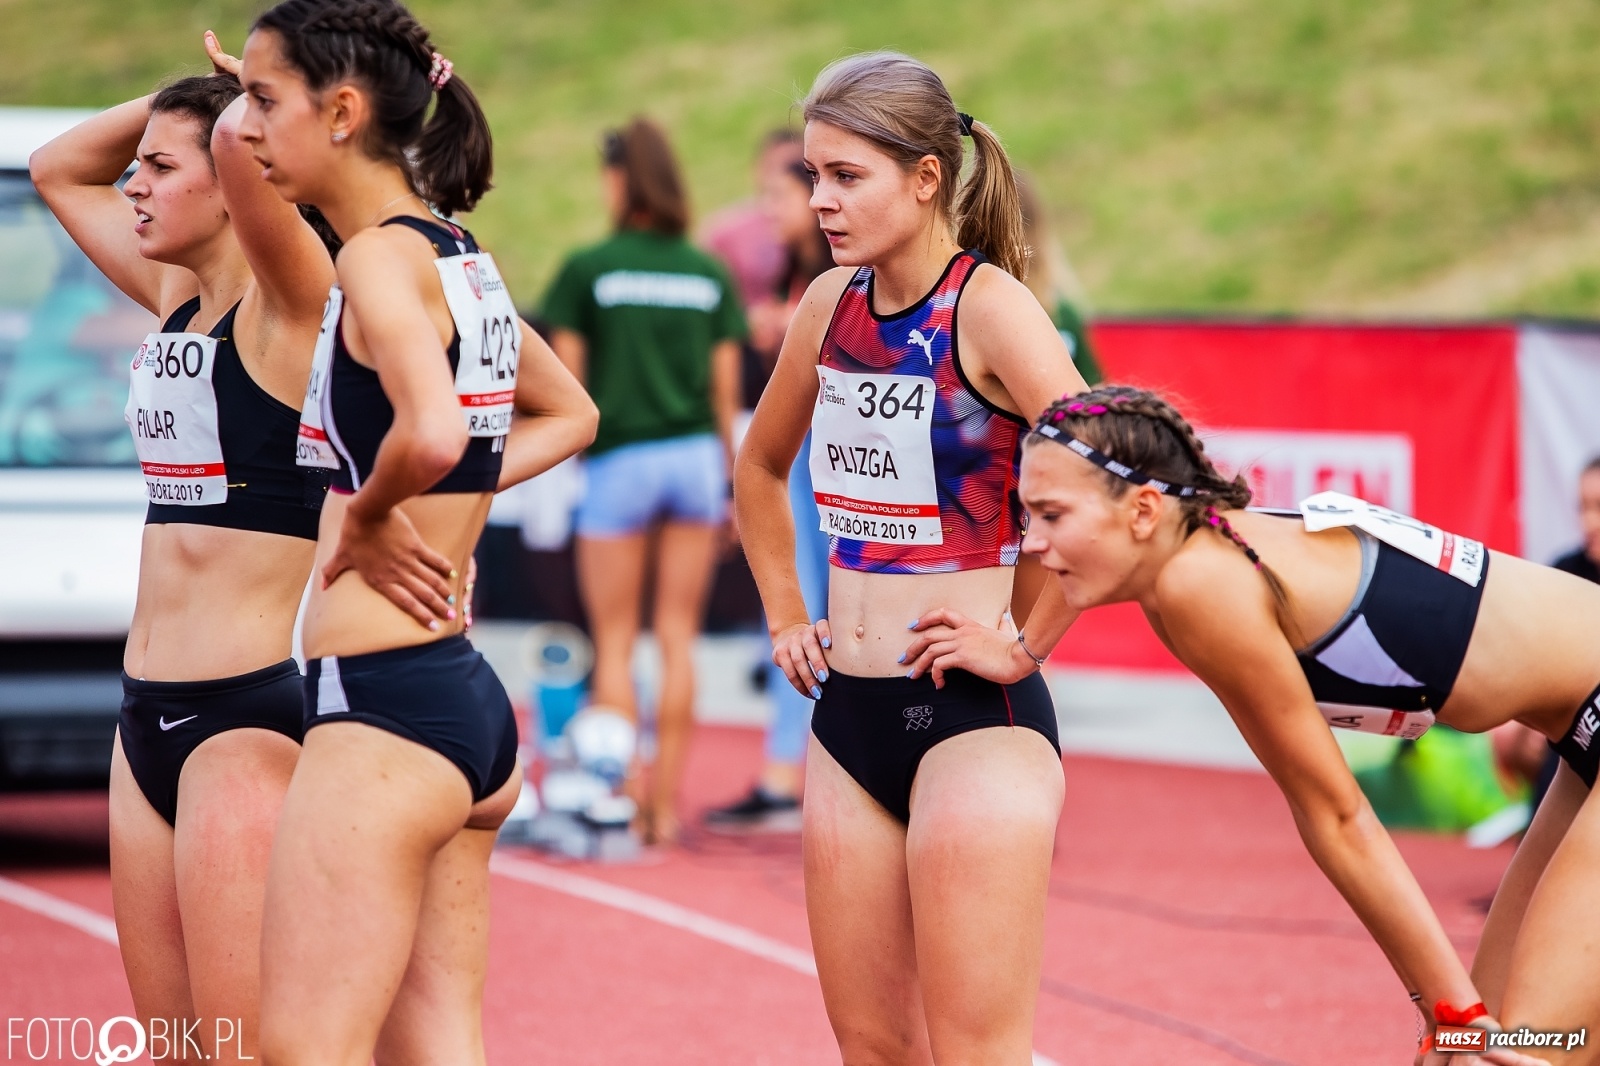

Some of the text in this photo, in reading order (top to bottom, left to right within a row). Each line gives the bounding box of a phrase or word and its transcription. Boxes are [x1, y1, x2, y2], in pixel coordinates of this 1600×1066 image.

[154, 340, 204, 379] 360
[480, 315, 518, 382] 423
[857, 381, 925, 420] 364
[137, 408, 177, 439] FILAR
[826, 443, 900, 481] PLIZGA
[1039, 424, 1061, 439] NIKE
[1067, 438, 1095, 458] NIKE
[1104, 460, 1134, 479] NIKE
[1146, 478, 1171, 494] NIKE
[174, 484, 203, 500] 2019
[878, 505, 902, 514] POLSKI
[902, 507, 920, 515] U20
[828, 514, 917, 540] RACIBÓRZ 2019
[1572, 706, 1600, 751] NIKE
